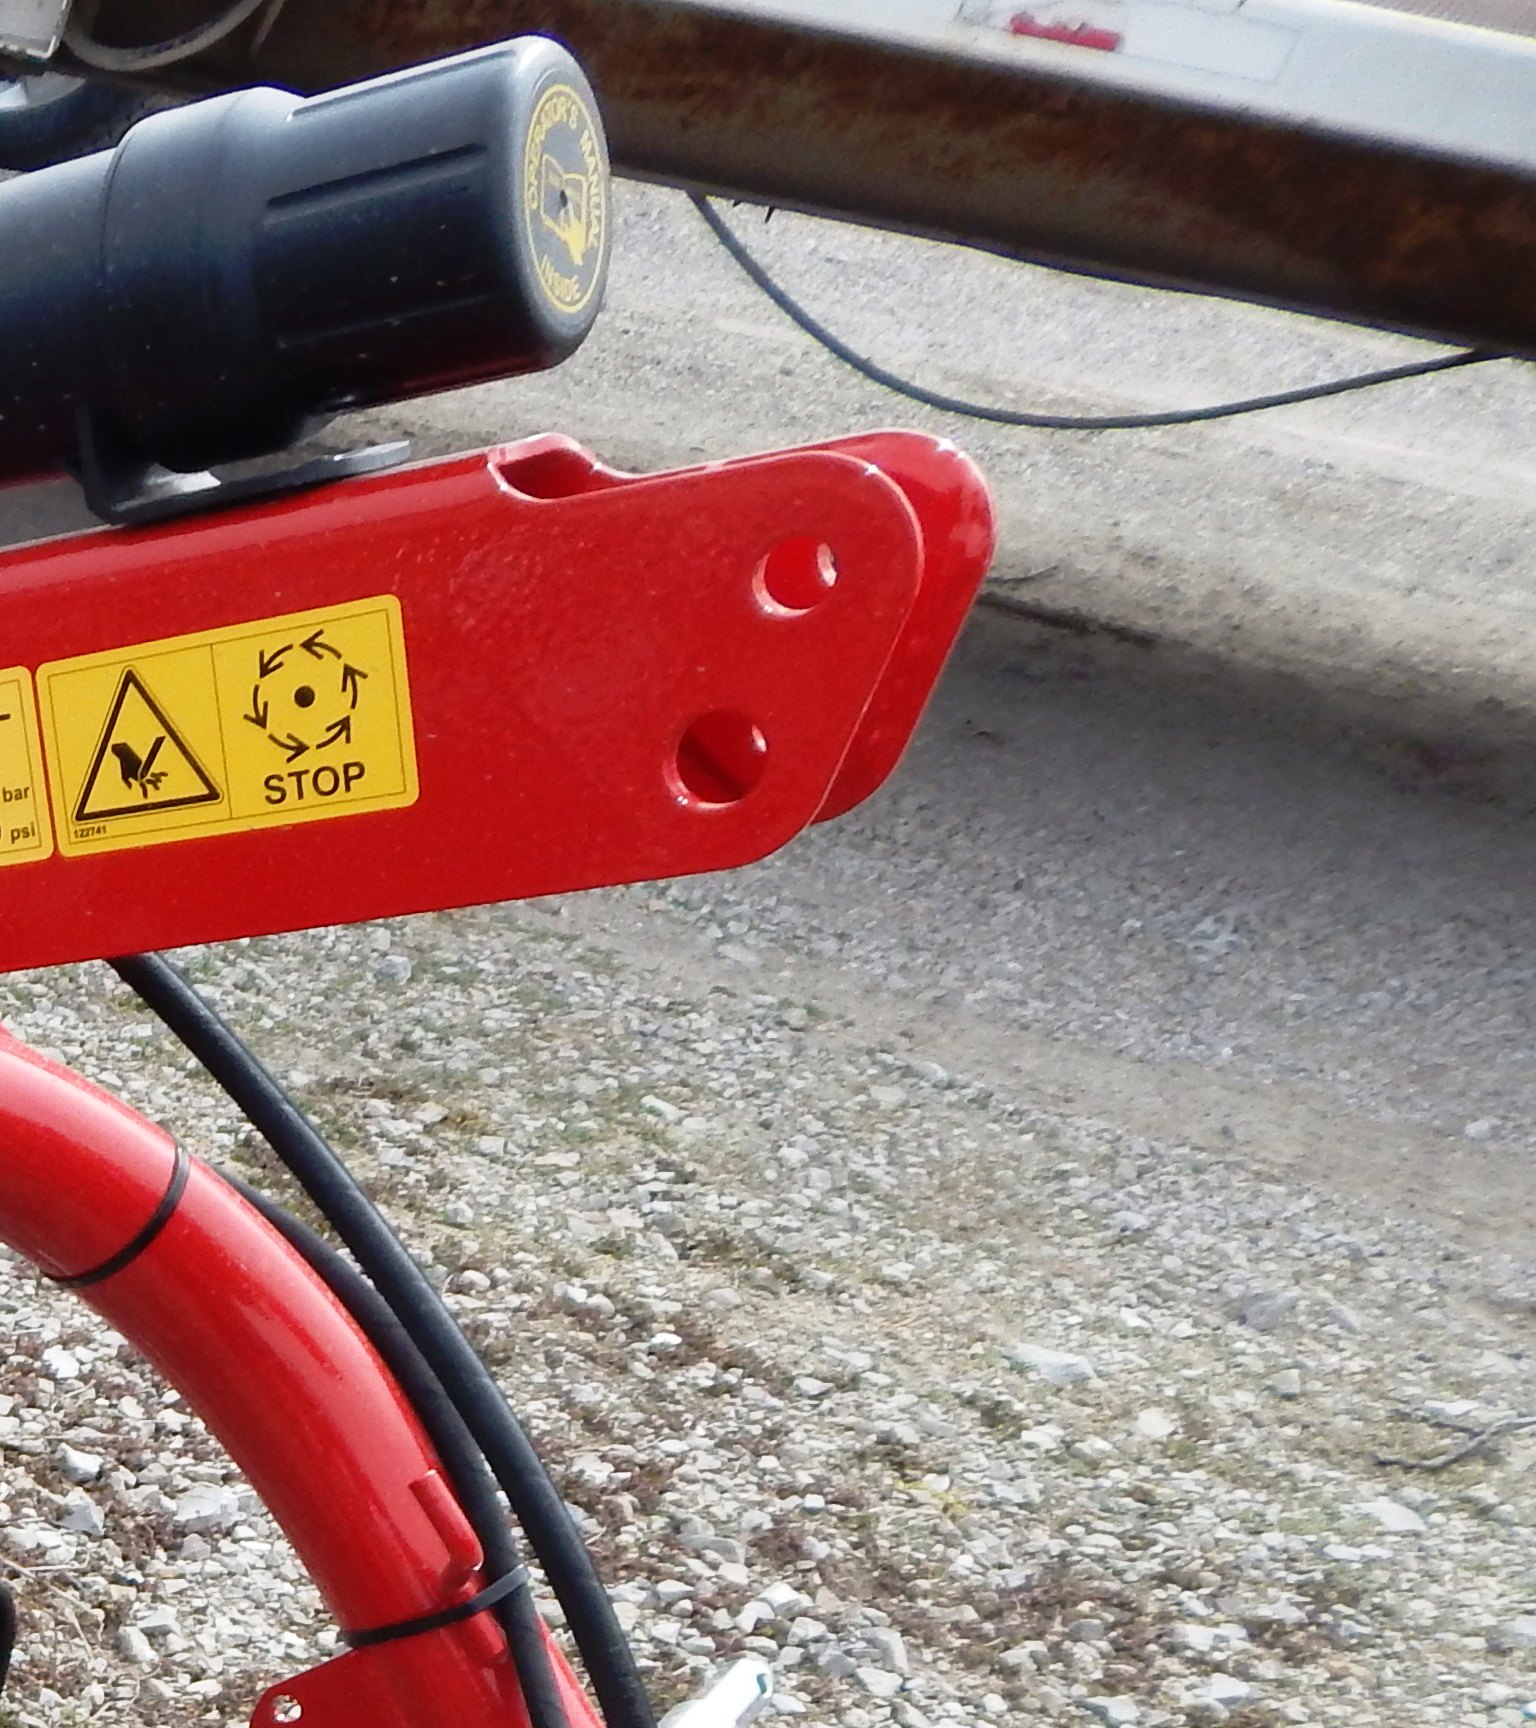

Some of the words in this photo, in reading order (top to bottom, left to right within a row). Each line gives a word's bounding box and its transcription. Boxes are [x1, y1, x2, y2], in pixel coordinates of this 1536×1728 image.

[529, 95, 578, 209] OPERATOR'S
[579, 129, 602, 248] MANUAL
[541, 254, 581, 302] INSIDE
[2, 786, 30, 803] bar
[264, 761, 365, 804] STOP
[10, 821, 36, 844] psi
